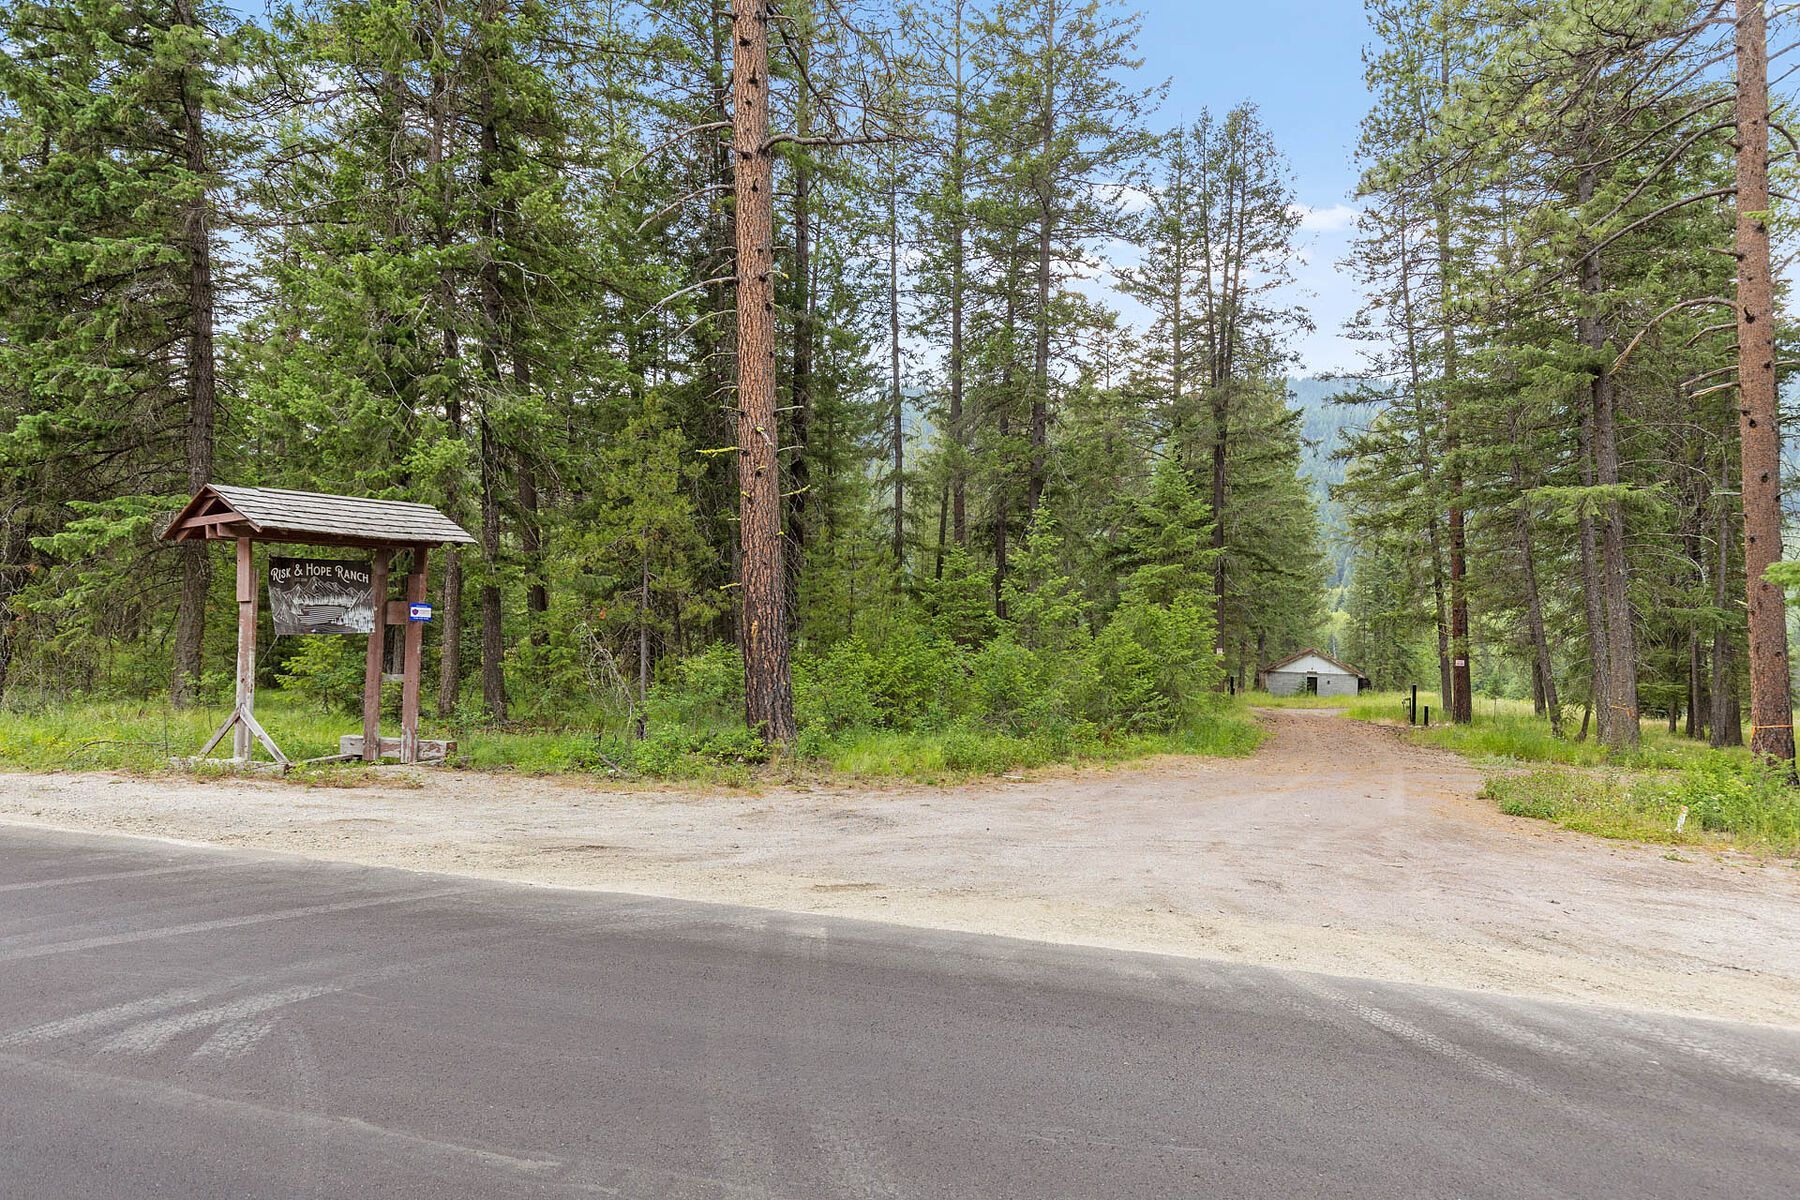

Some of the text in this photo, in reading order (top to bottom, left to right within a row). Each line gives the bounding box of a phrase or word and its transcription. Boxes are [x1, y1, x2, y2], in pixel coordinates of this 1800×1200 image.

[271, 563, 369, 583] RISK & HOPE RANCH
